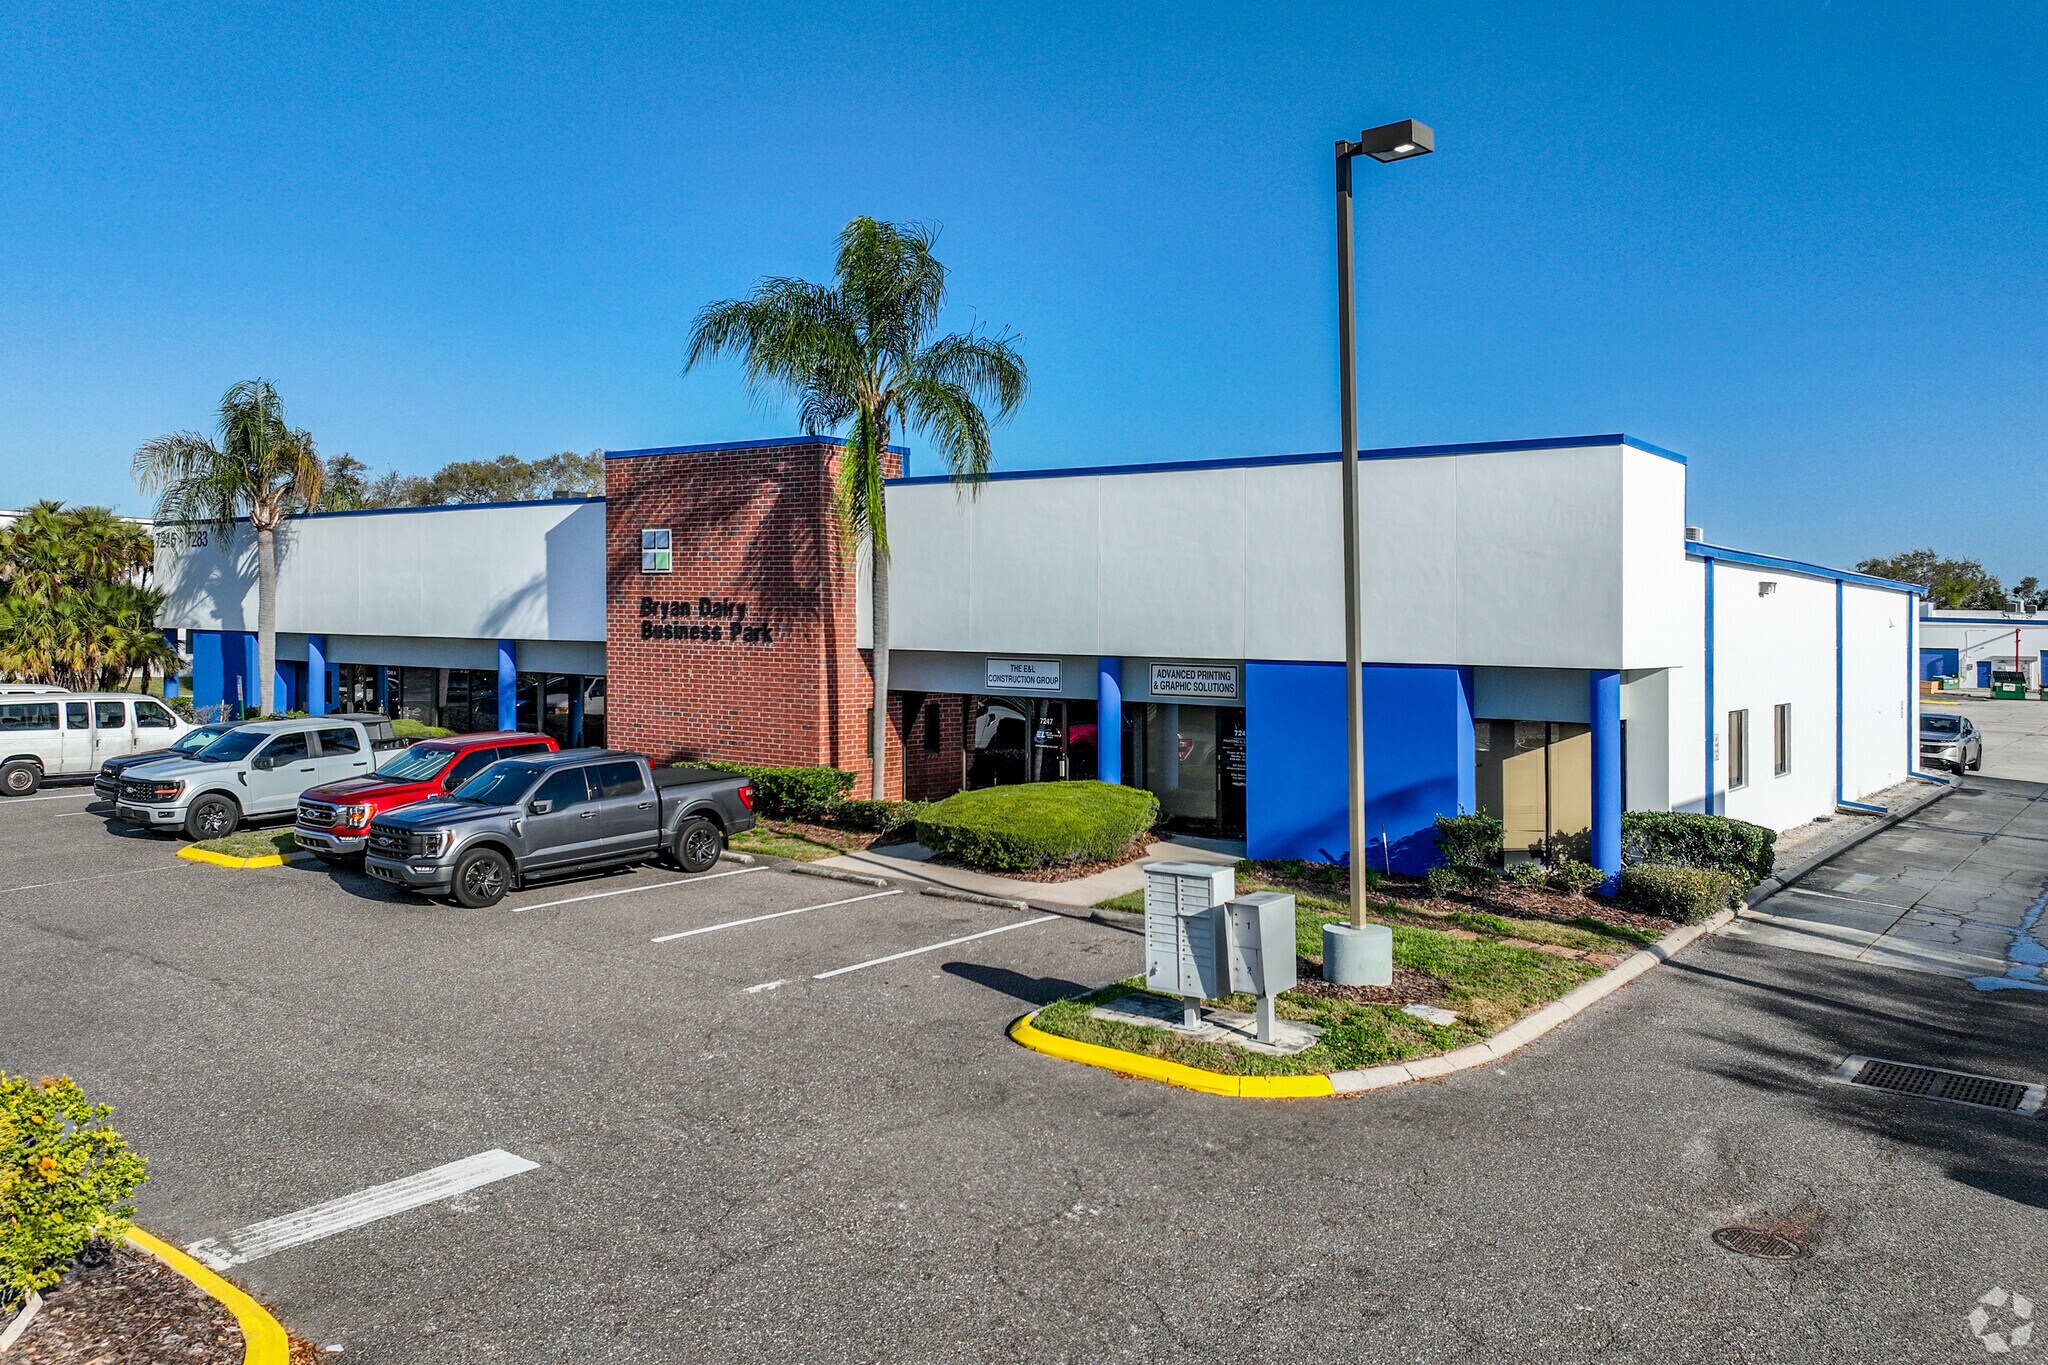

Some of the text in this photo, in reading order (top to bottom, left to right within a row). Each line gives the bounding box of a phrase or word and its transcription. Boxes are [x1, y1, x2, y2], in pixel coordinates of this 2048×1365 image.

[639, 597, 746, 622] Bryan Dairy
[641, 620, 773, 642] Business Park
[1010, 664, 1035, 673] THE E&L
[989, 674, 1058, 685] CONSTRUCTION GROUP
[1157, 669, 1231, 681] ADVANCED PRINTING
[1154, 681, 1235, 693] & GRAPHIC SOLUTIONS
[1246, 922, 1250, 930] 1
[1247, 967, 1252, 975] 2
